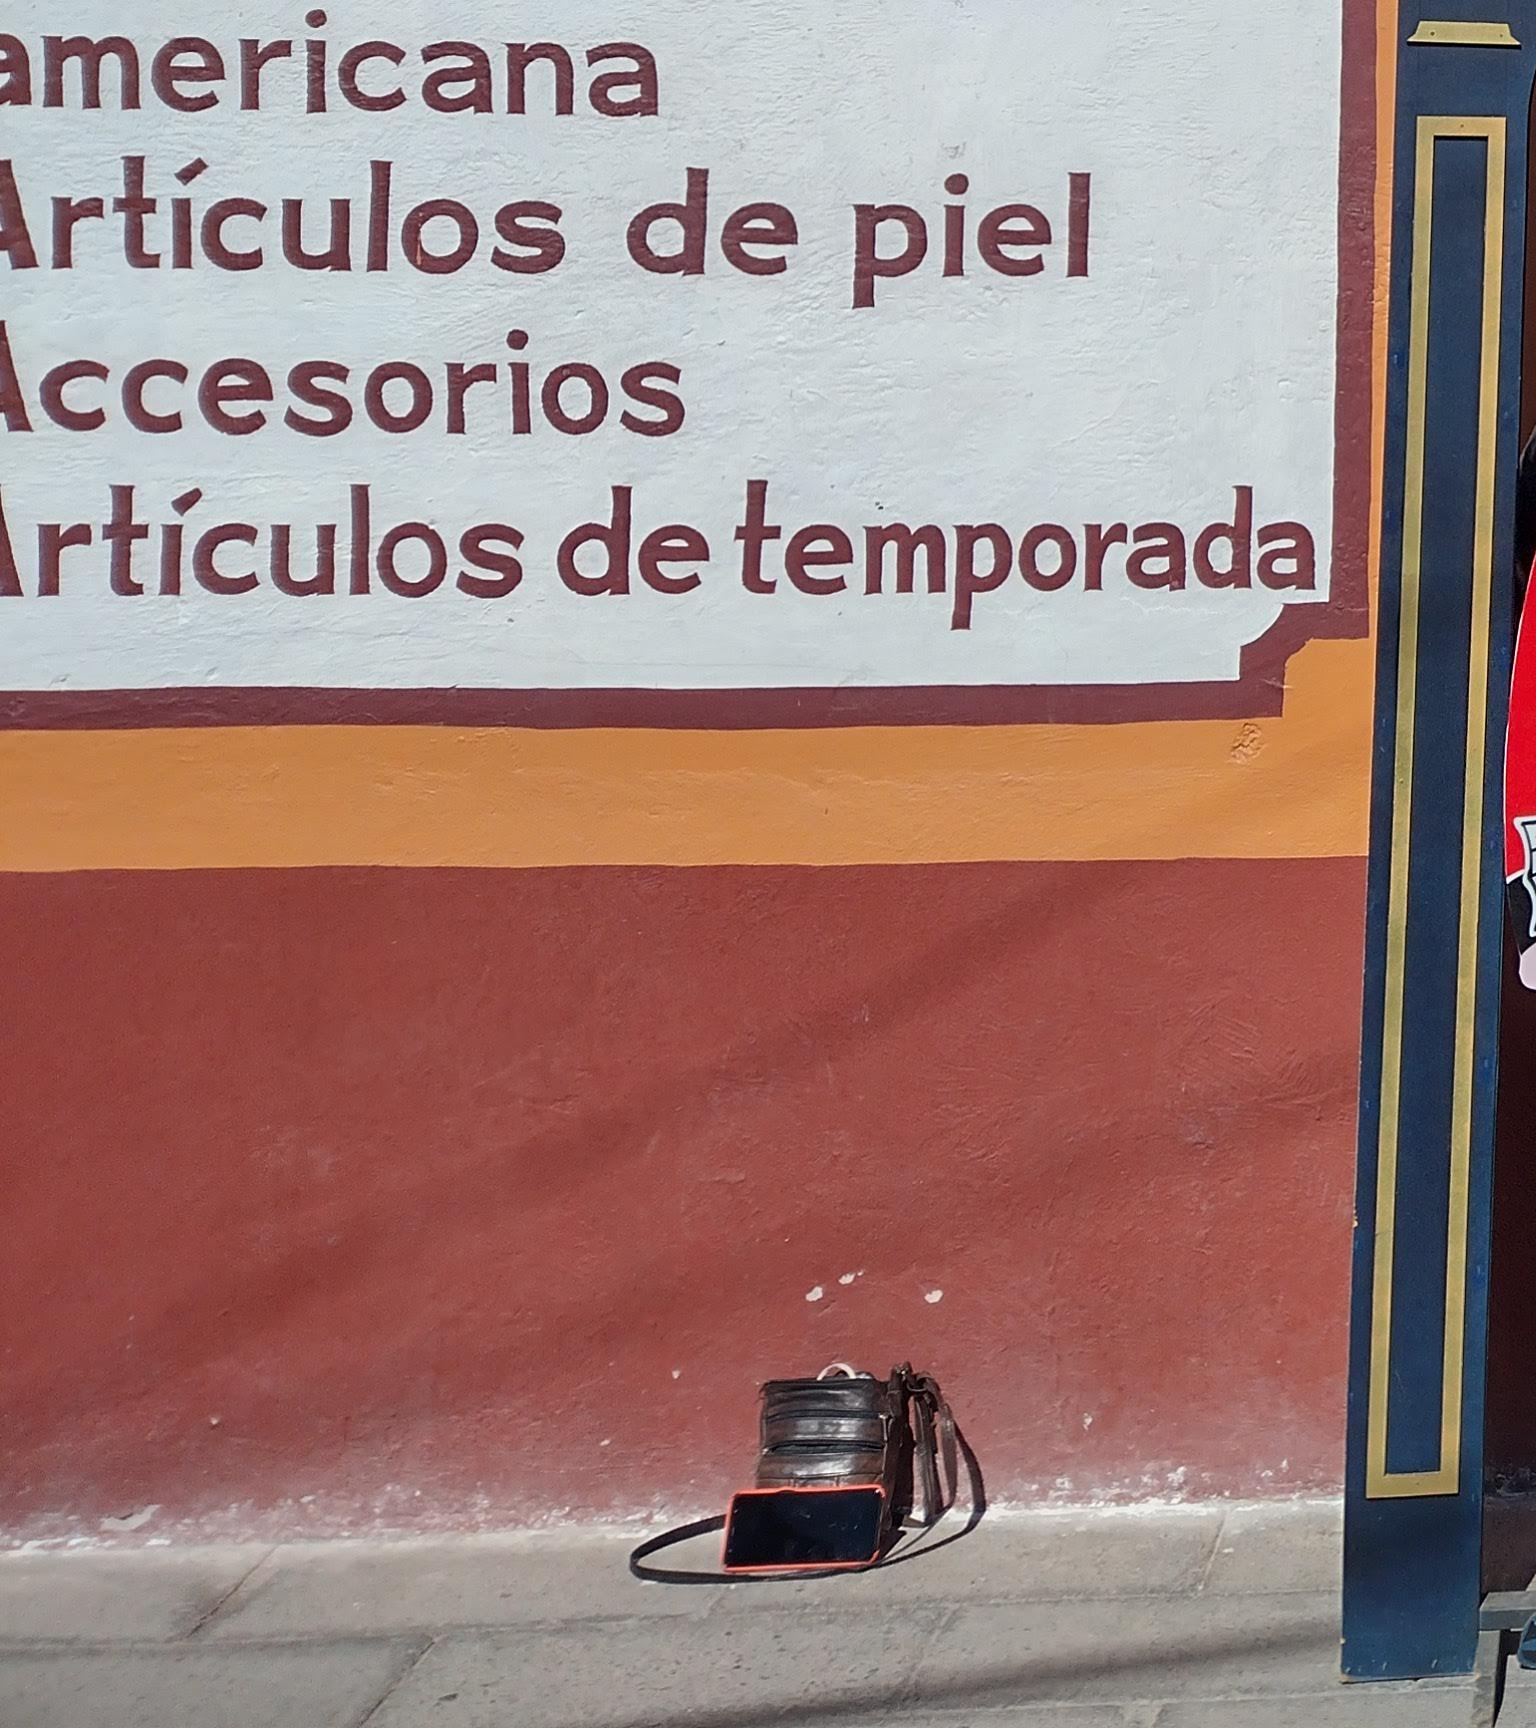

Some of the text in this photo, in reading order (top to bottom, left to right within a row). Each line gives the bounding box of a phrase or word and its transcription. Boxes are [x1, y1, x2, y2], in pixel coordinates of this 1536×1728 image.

[626, 167, 798, 276] de
[851, 170, 1092, 308] piel
[0, 478, 1317, 630] rtículos de temporada
